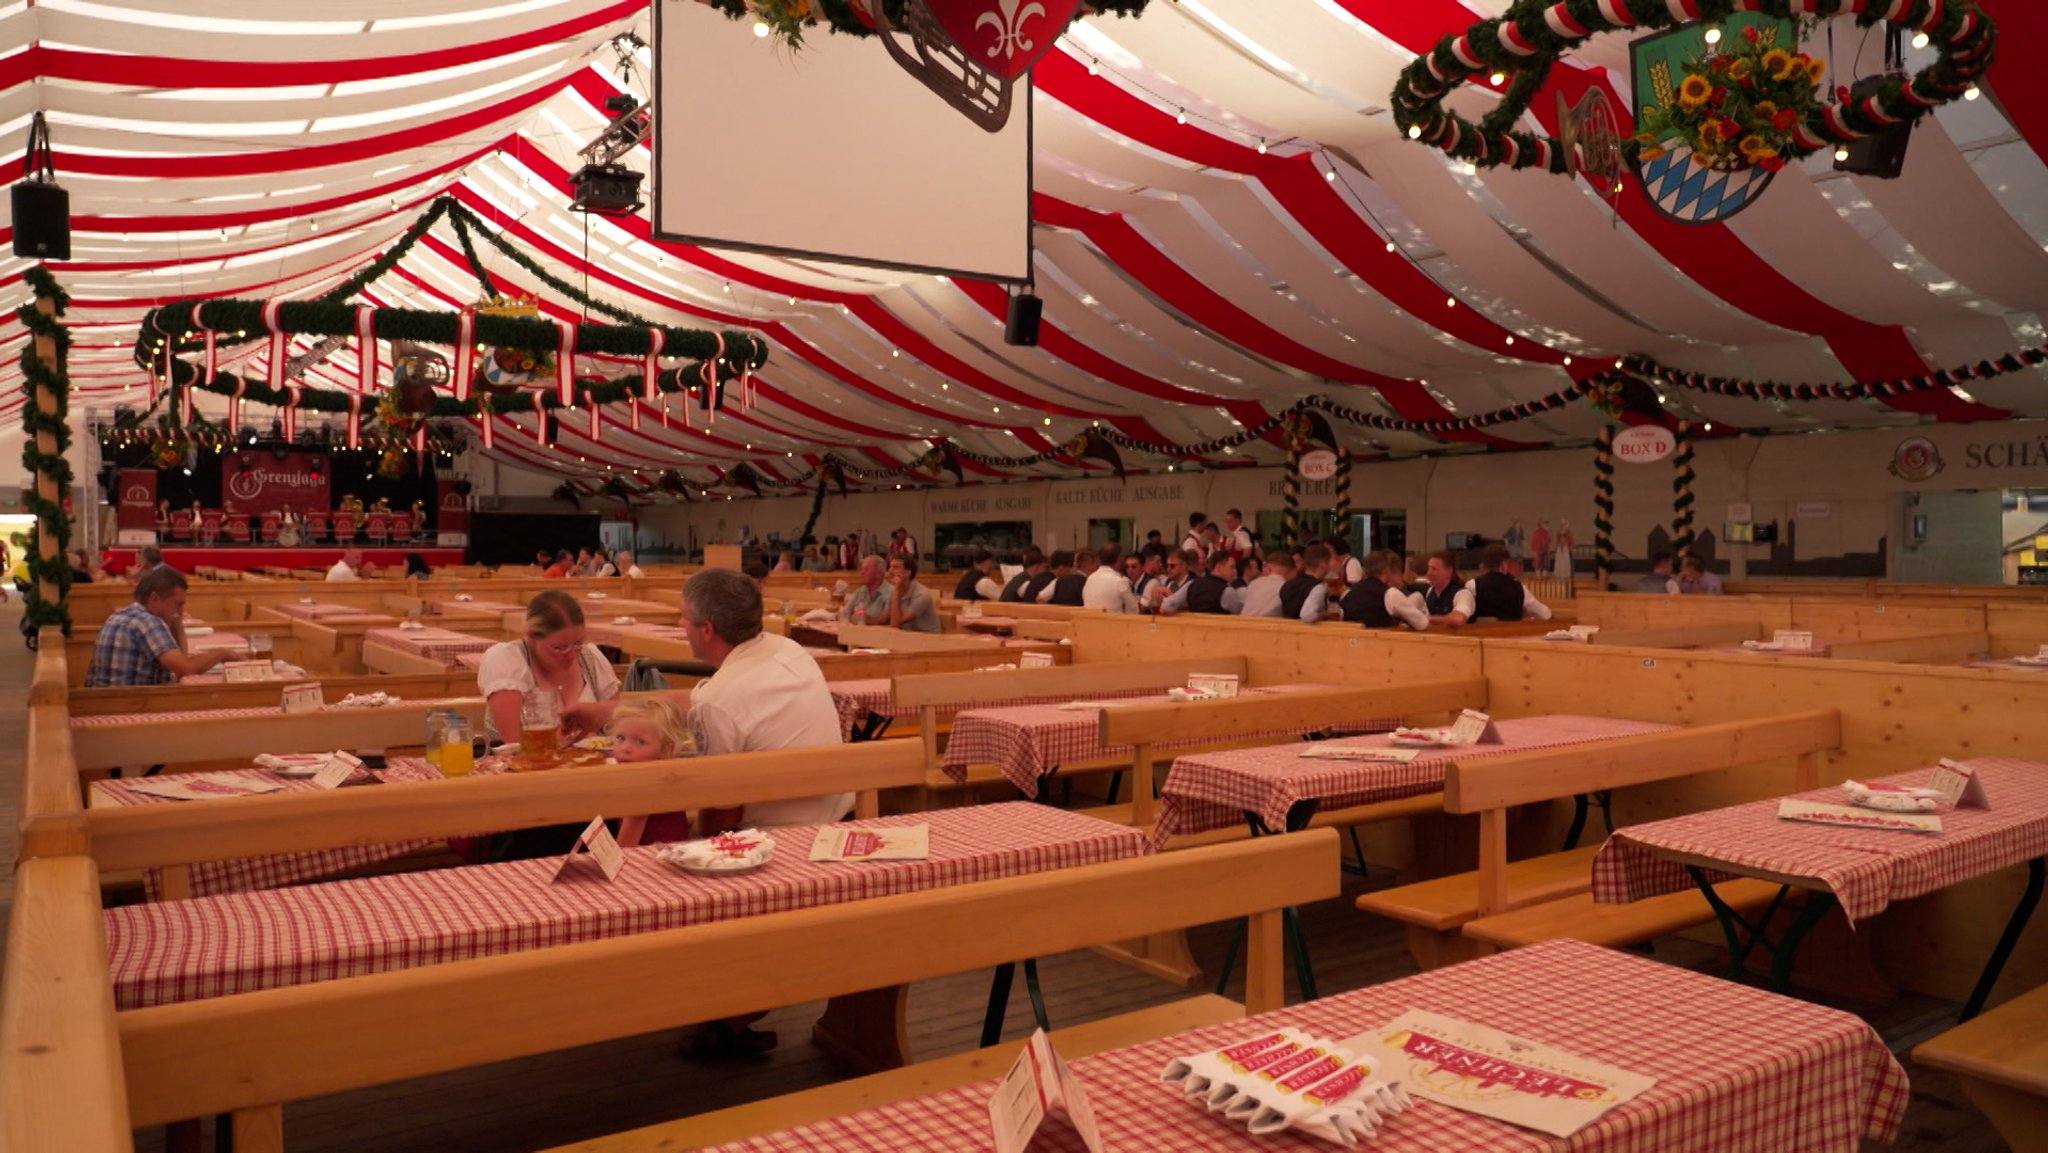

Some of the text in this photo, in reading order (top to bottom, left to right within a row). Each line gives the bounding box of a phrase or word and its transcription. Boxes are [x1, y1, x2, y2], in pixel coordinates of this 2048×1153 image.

[1620, 441, 1667, 456] BOX D
[1304, 463, 1324, 475] BOX
[1055, 484, 1184, 504] KALTE KÜCHE AUSGABE
[994, 496, 1033, 511] AUSGABE
[1414, 1040, 1574, 1092] LECHNER
